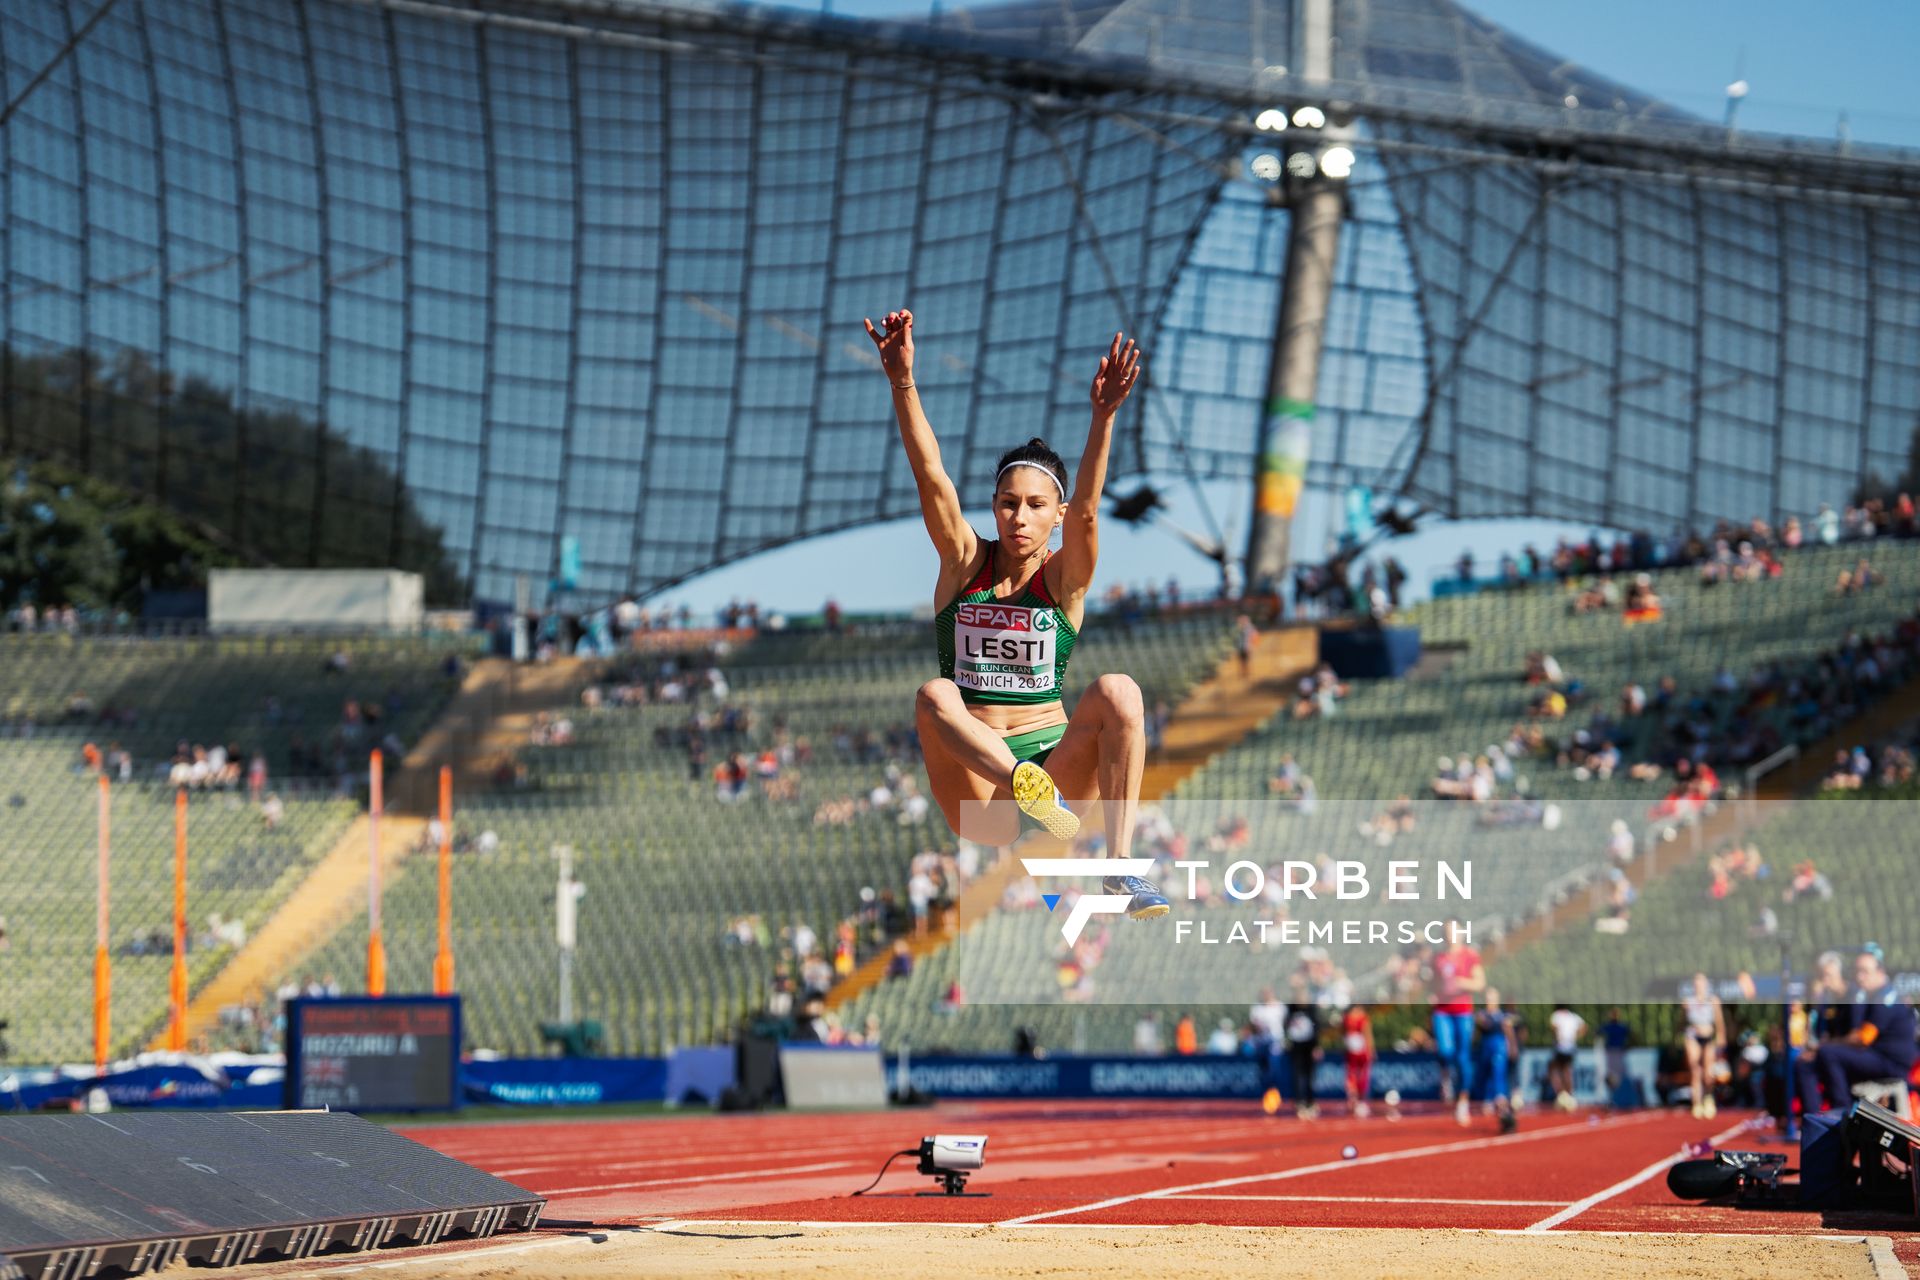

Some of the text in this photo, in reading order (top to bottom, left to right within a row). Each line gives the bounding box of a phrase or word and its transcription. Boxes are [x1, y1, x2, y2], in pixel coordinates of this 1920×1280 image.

[960, 606, 1029, 628] SPAR
[965, 635, 1044, 661] LESTI
[981, 664, 1000, 672] RUN
[1002, 665, 1031, 674] CLEAN
[960, 672, 1050, 688] MUNICH 2022
